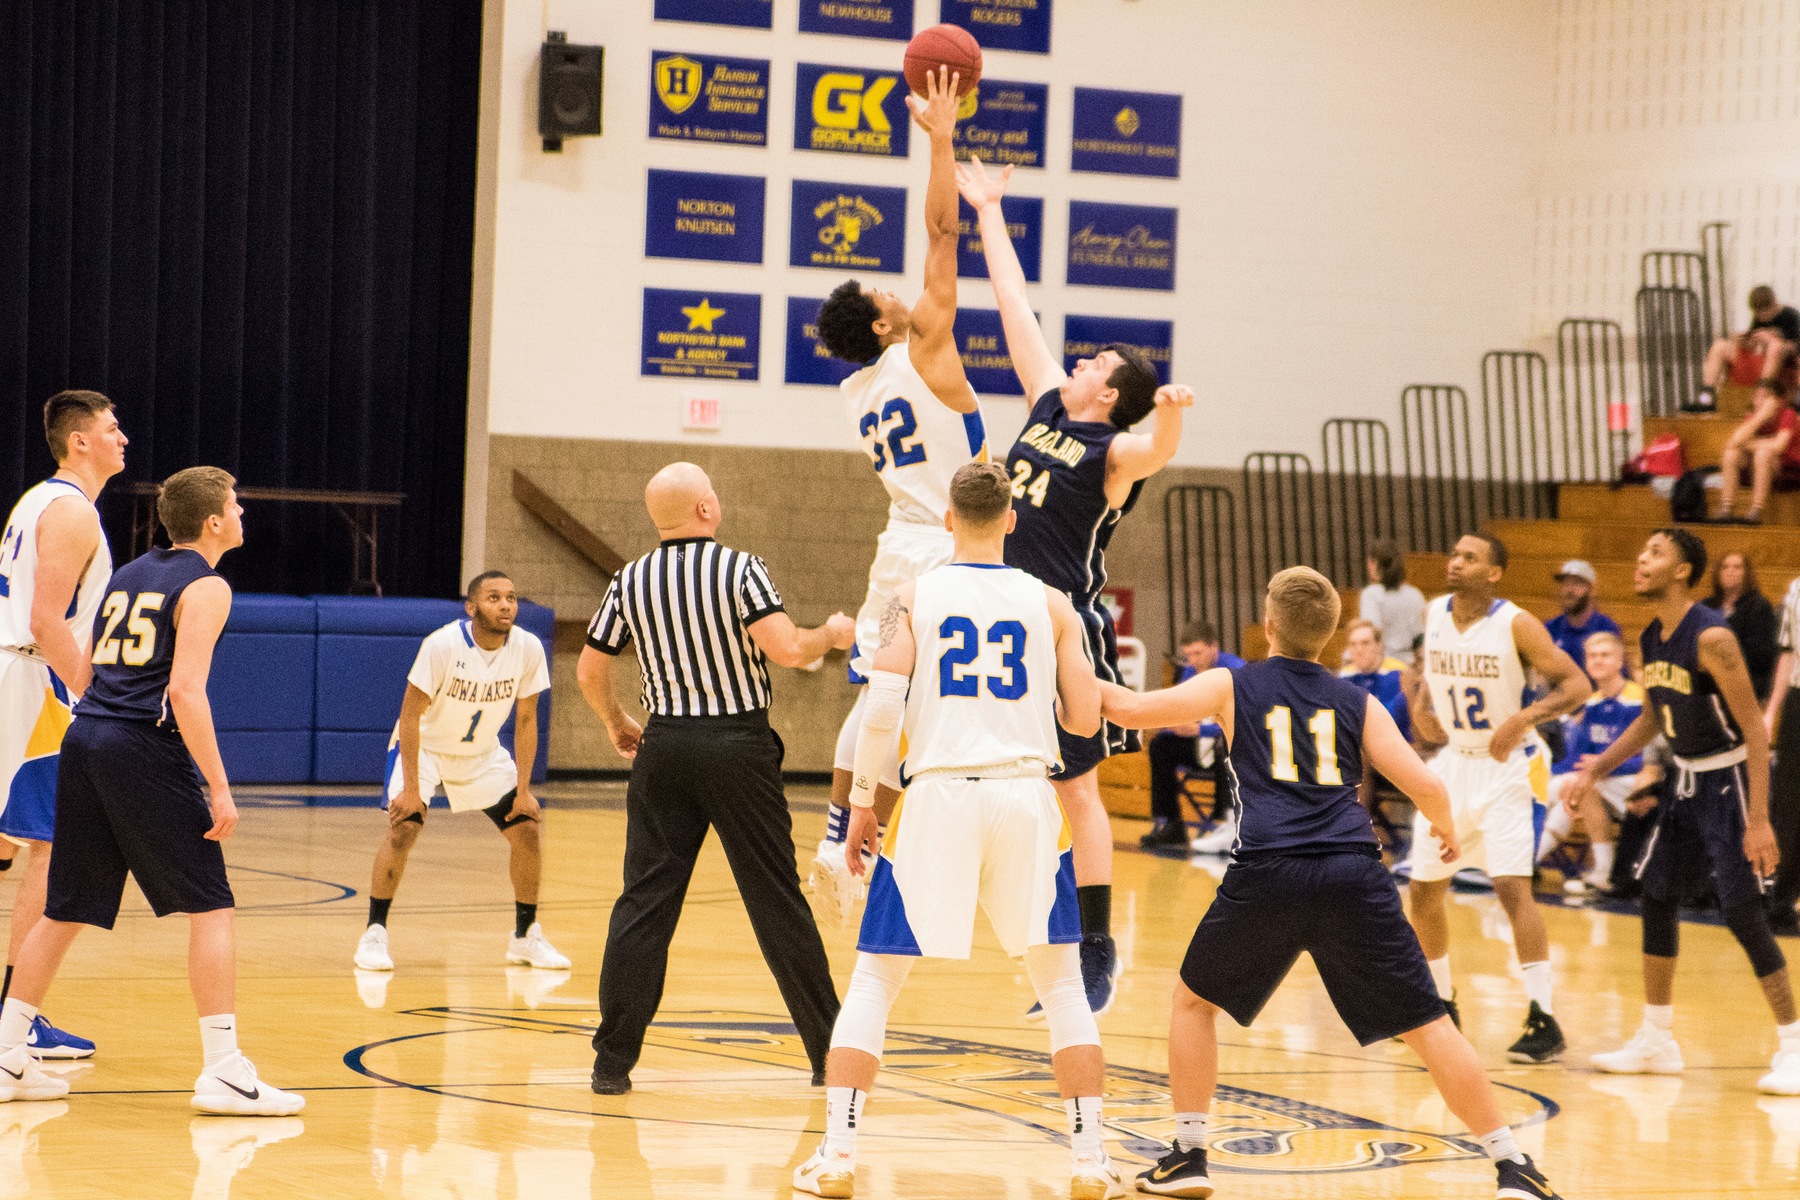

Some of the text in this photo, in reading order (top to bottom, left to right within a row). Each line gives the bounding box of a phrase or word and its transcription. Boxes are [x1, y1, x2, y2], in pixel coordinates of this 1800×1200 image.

[971, 8, 1022, 26] ROGERS
[667, 67, 690, 95] H
[812, 72, 898, 131] GK
[1002, 128, 1028, 145] and
[677, 198, 735, 217] NORTON
[675, 217, 735, 236] KNUTSEN
[718, 335, 746, 348] BANK
[1010, 459, 1051, 508] 24
[91, 590, 166, 667] 25
[938, 614, 1029, 702] 23
[1429, 650, 1500, 678] IOWA LAKES
[447, 677, 515, 702] IOWA LAKES
[1448, 684, 1492, 730] 12
[460, 709, 483, 742] 1
[1266, 705, 1344, 786] 11
